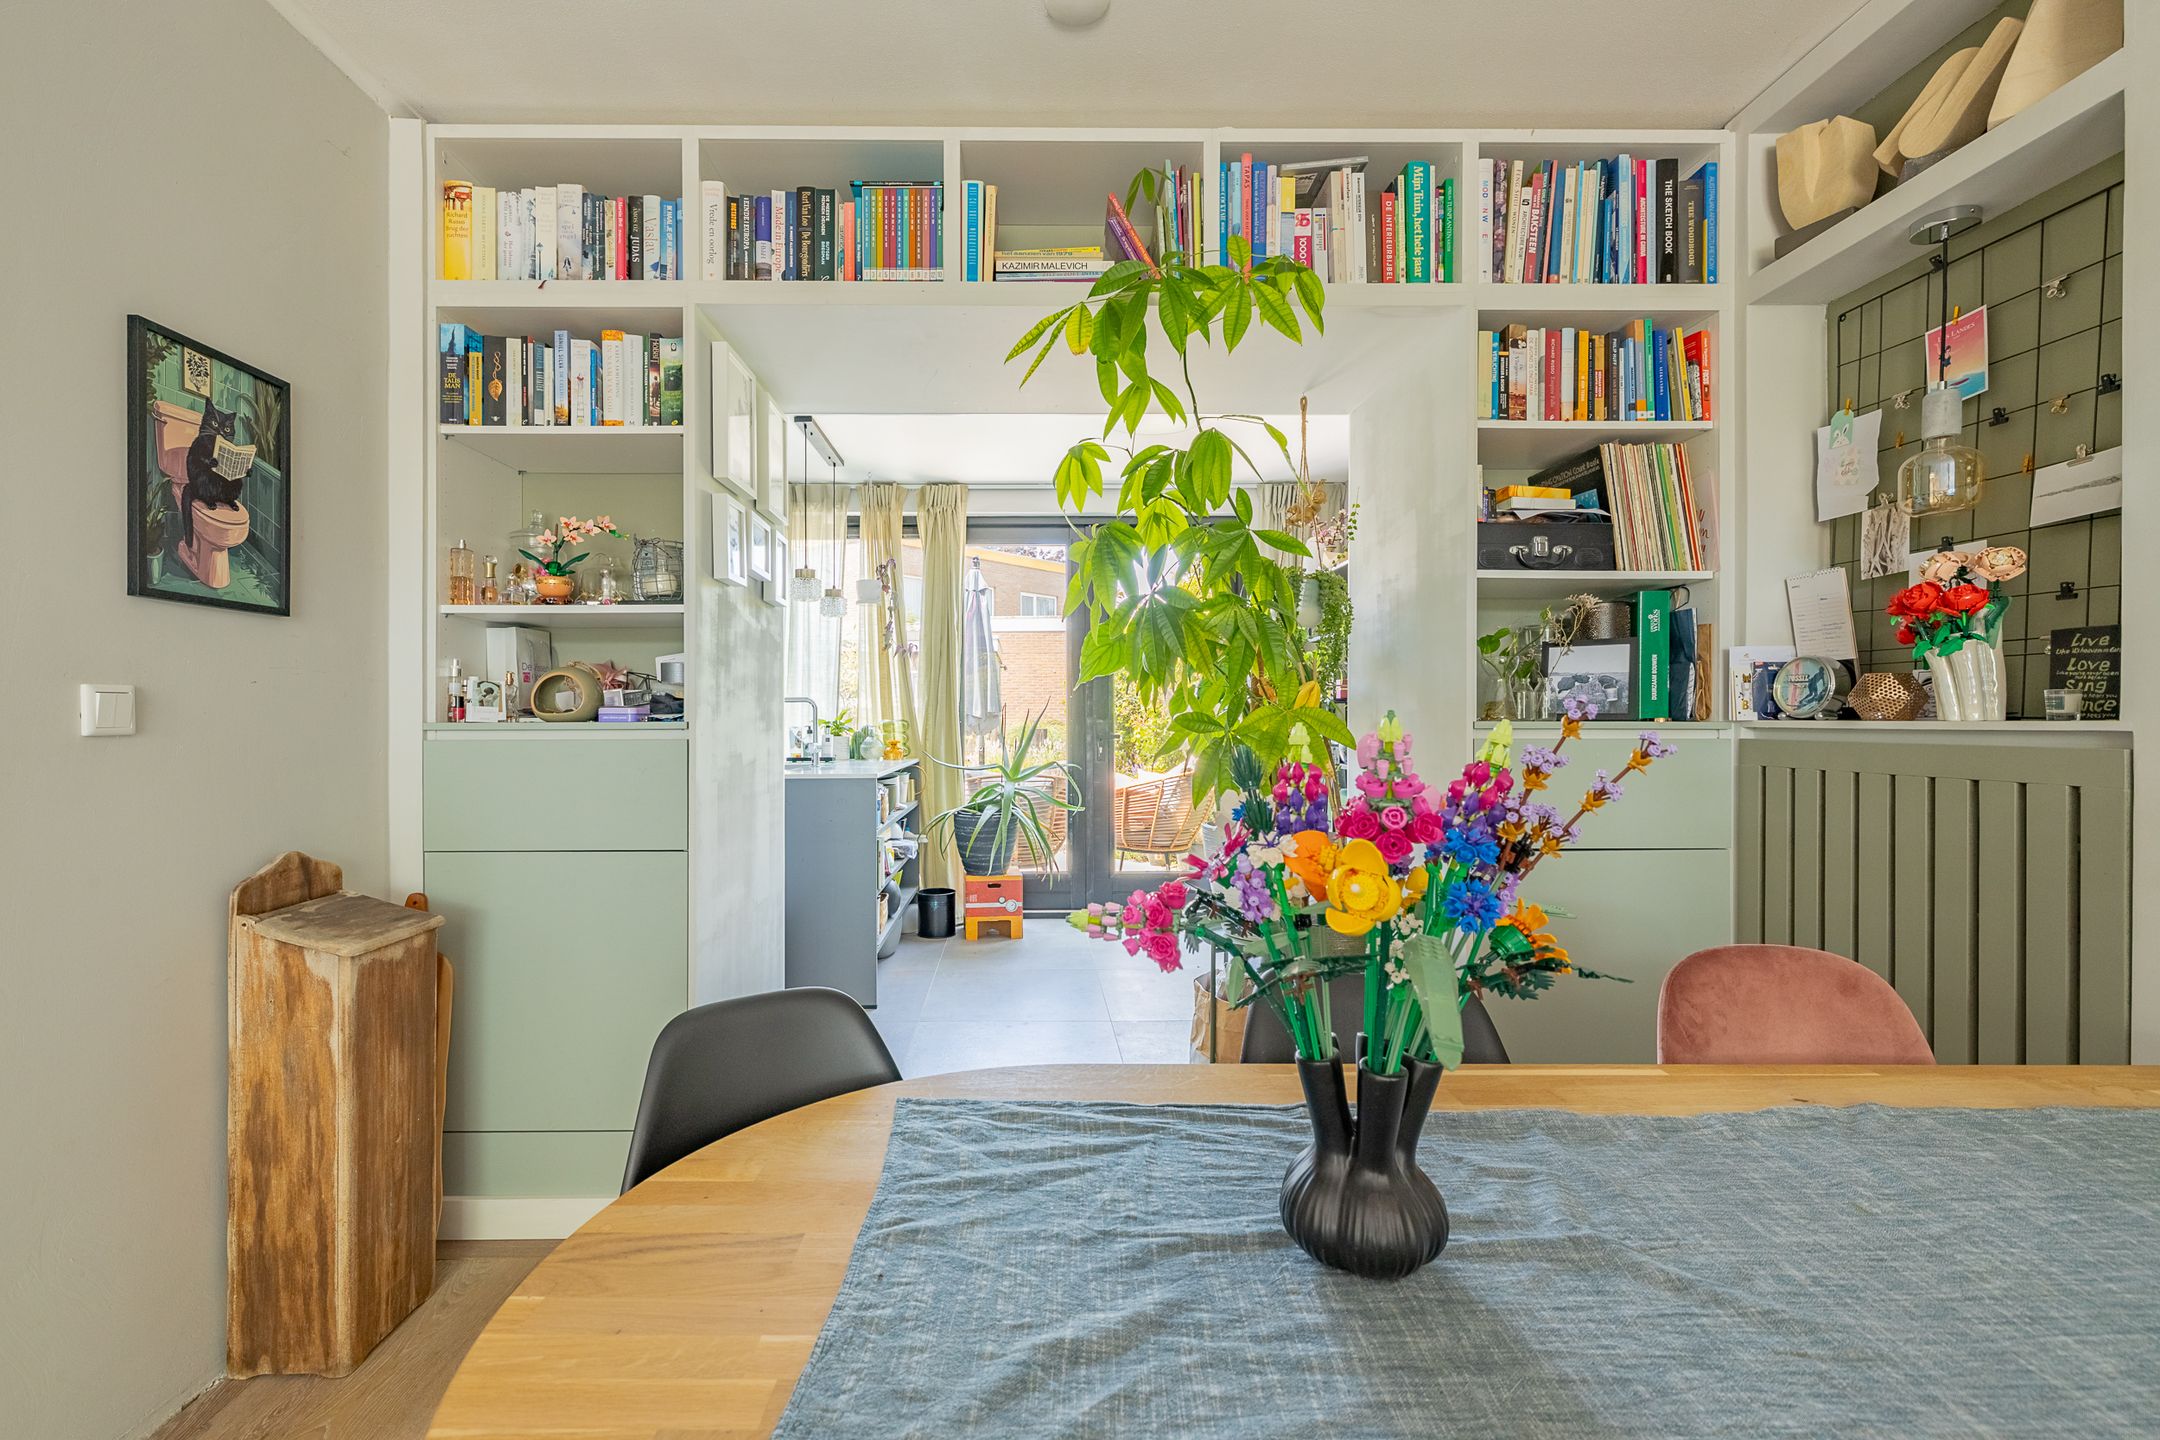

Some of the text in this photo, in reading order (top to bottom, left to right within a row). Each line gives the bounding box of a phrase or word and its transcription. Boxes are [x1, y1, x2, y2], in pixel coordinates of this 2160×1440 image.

[802, 192, 811, 226] Bart Van Loo
[1386, 200, 1393, 211] DE
[1412, 166, 1424, 278] Mijn Tuin, het hele jaar
[1665, 180, 1673, 254] THE SKETCH BOOK
[706, 204, 718, 264] Vrede en oorlog
[773, 206, 784, 273] Made in Europe
[1520, 210, 1528, 246] ARCHITECTURE
[1528, 208, 1540, 254] BAKSTEEN
[630, 235, 640, 262] JUDAS
[1002, 262, 1088, 270] KAZIMIR MALEVICH
[2071, 633, 2110, 647] Live
[2066, 658, 2110, 672] Love
